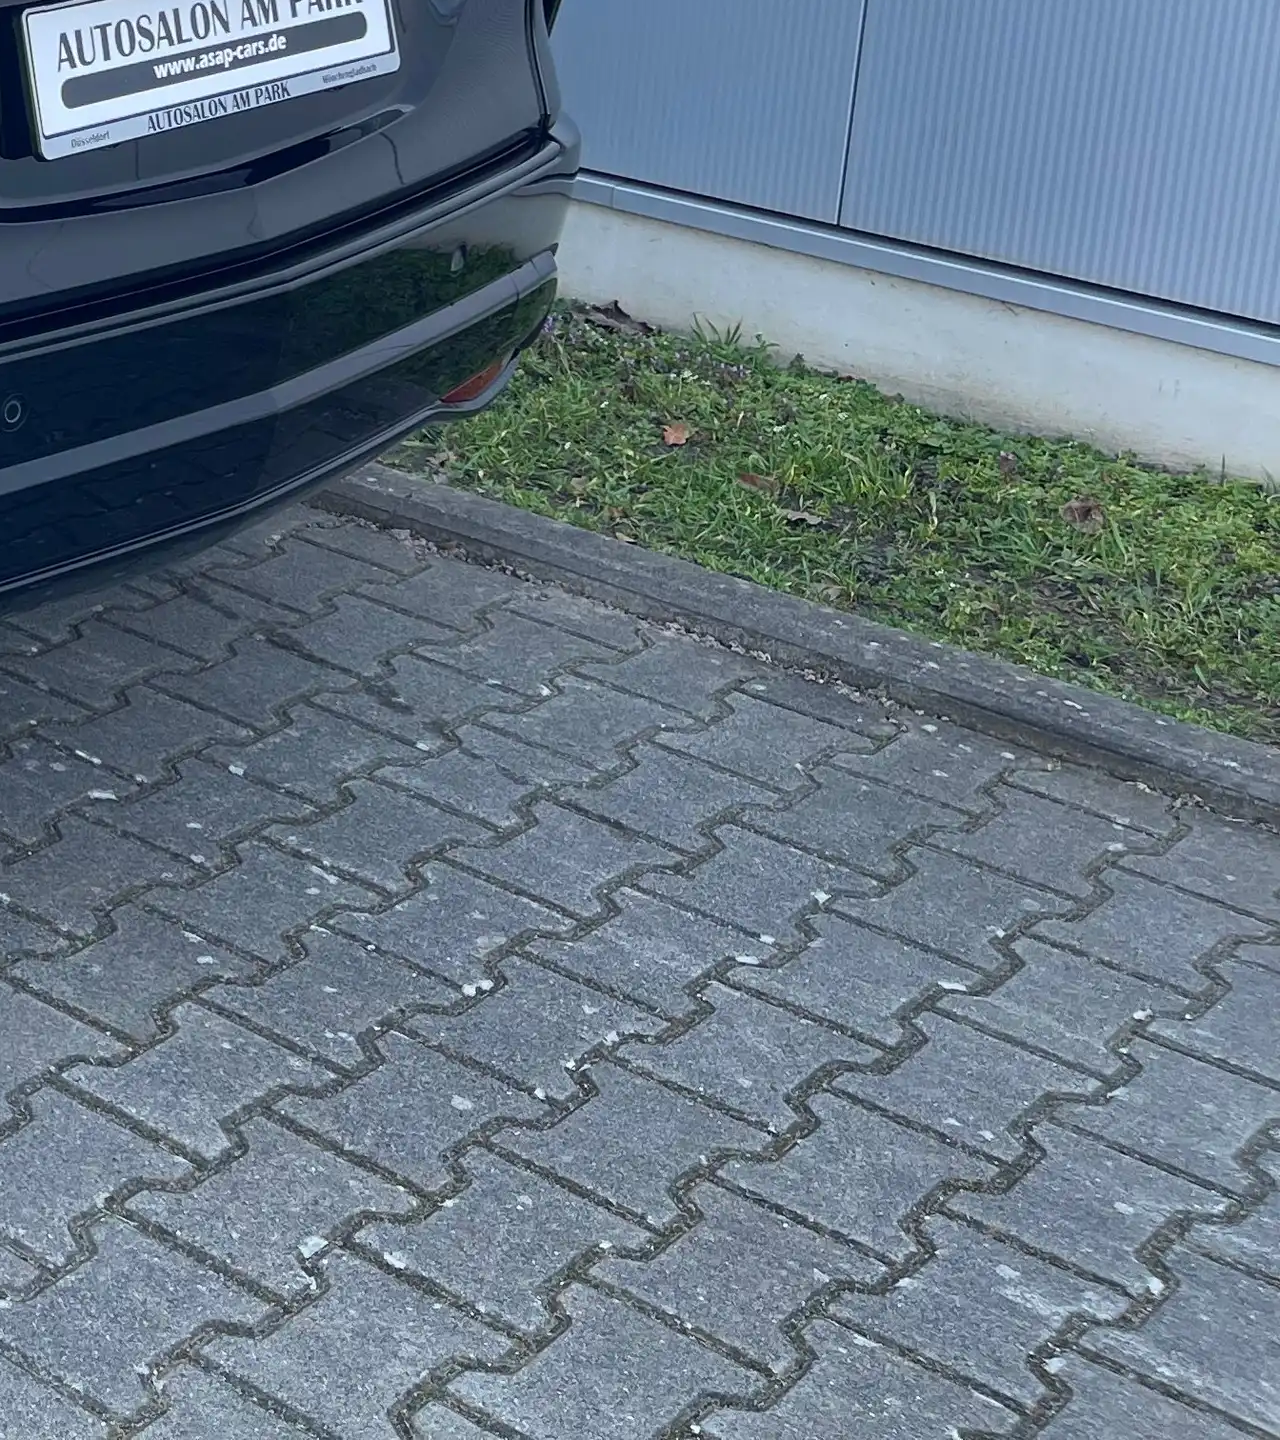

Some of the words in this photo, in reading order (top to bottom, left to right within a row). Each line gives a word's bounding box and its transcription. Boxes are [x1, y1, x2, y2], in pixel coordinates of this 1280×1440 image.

[153, 34, 288, 79] www.asap-cars.de
[147, 97, 228, 133] AUTOSALON
[231, 92, 251, 111] AM
[255, 81, 291, 105] PARK
